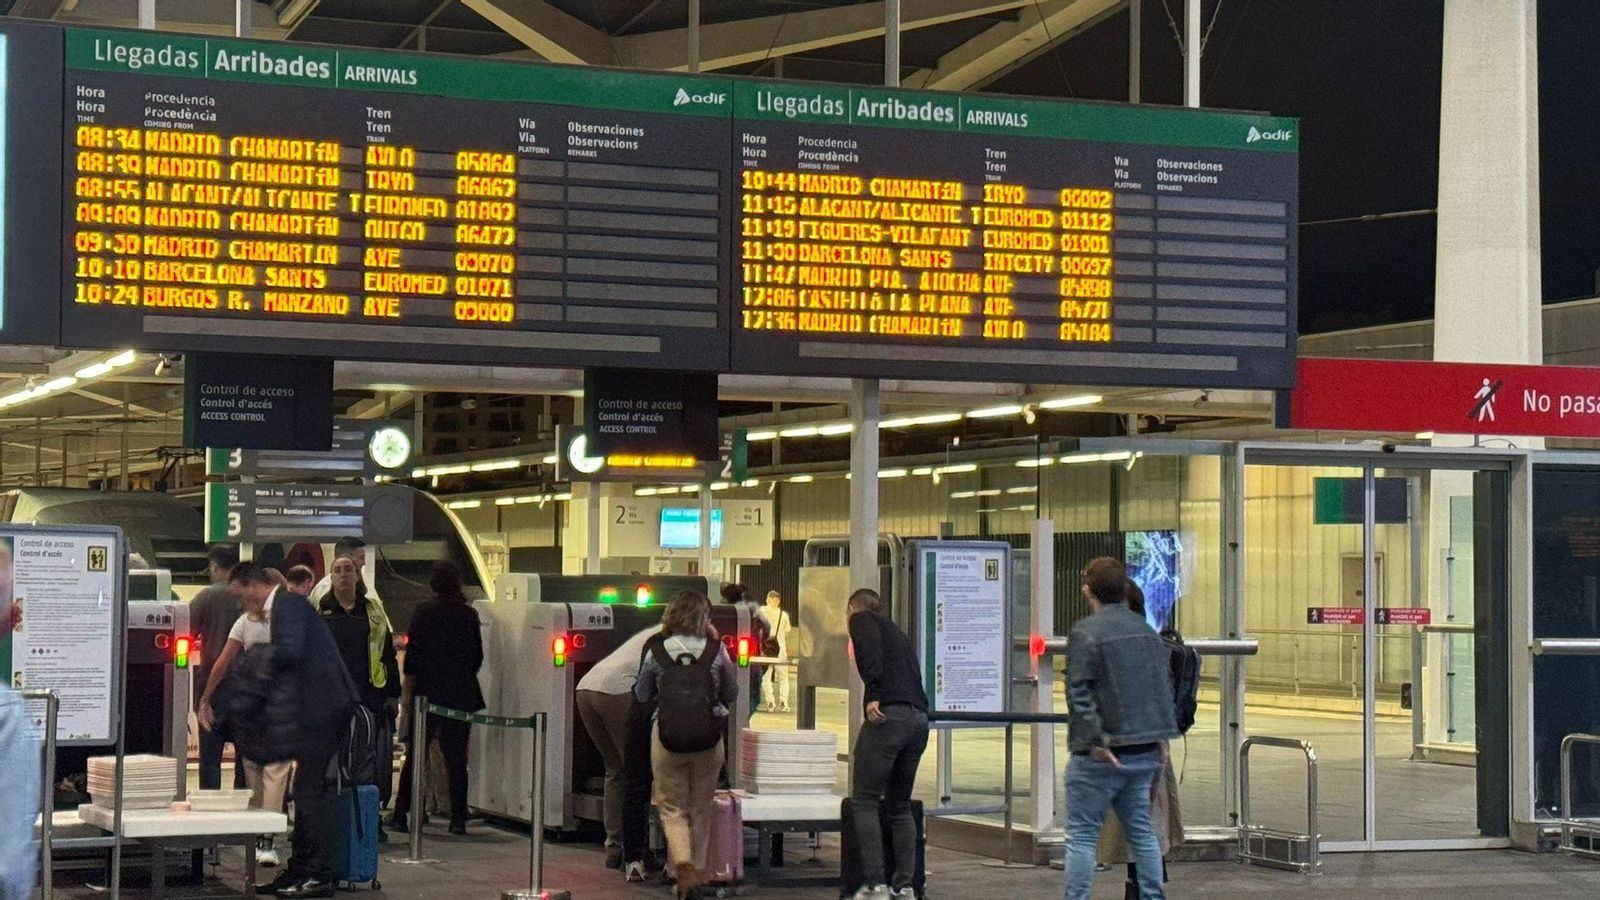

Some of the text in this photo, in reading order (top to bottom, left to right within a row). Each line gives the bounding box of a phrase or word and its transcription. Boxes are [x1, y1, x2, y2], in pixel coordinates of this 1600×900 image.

[94, 38, 417, 85] Llegadas Arribades ARRIVALS
[77, 86, 105, 98] Hora
[691, 92, 726, 105] adif
[77, 100, 105, 112] Hora
[144, 92, 216, 107] Procedencia
[144, 106, 216, 122] Procedència
[366, 107, 392, 118] Tren
[758, 91, 1028, 128] Llegadas Arribades ARRIVALS
[366, 121, 392, 133] Tren
[568, 122, 644, 137] Observaciones
[742, 133, 766, 144] Hora
[1262, 130, 1292, 141] adif
[568, 136, 638, 150] Observacions
[798, 136, 858, 150] Procedencia
[742, 146, 766, 158] Hora
[798, 150, 858, 163] Procedència
[985, 148, 1006, 159] Tren
[985, 161, 1006, 172] Tren
[1156, 158, 1223, 172] Observaciones
[743, 171, 796, 191] 10:44
[799, 174, 864, 195] MADRID
[1156, 171, 1218, 184] Observacions
[984, 207, 1056, 228] EUROMED
[1060, 211, 1112, 231] 01112
[983, 230, 1056, 250] EUROMED
[144, 235, 220, 258] MADRID
[365, 248, 400, 267] AVE
[799, 244, 893, 266] BARCELONA
[900, 249, 953, 268] SANTS
[76, 257, 141, 279] 10:10
[144, 261, 256, 285] BARCELONA
[265, 267, 326, 288] SANTS
[365, 272, 447, 294] EUROMED
[77, 284, 139, 305] 10:24
[144, 287, 219, 308] BURGOS
[228, 291, 250, 310] R.
[264, 292, 349, 314] MANZANO
[364, 297, 399, 317] AVE
[200, 384, 295, 397] Control de acceso
[200, 398, 235, 408] Control
[598, 398, 683, 410] Control de acceso
[1523, 389, 1550, 412] No
[201, 412, 266, 422] ACCESS CONTROL
[598, 412, 630, 421] Control
[599, 425, 656, 434] ACCESS CONTROL
[616, 505, 626, 524] 2
[754, 508, 762, 525] 1
[228, 512, 242, 536] 3
